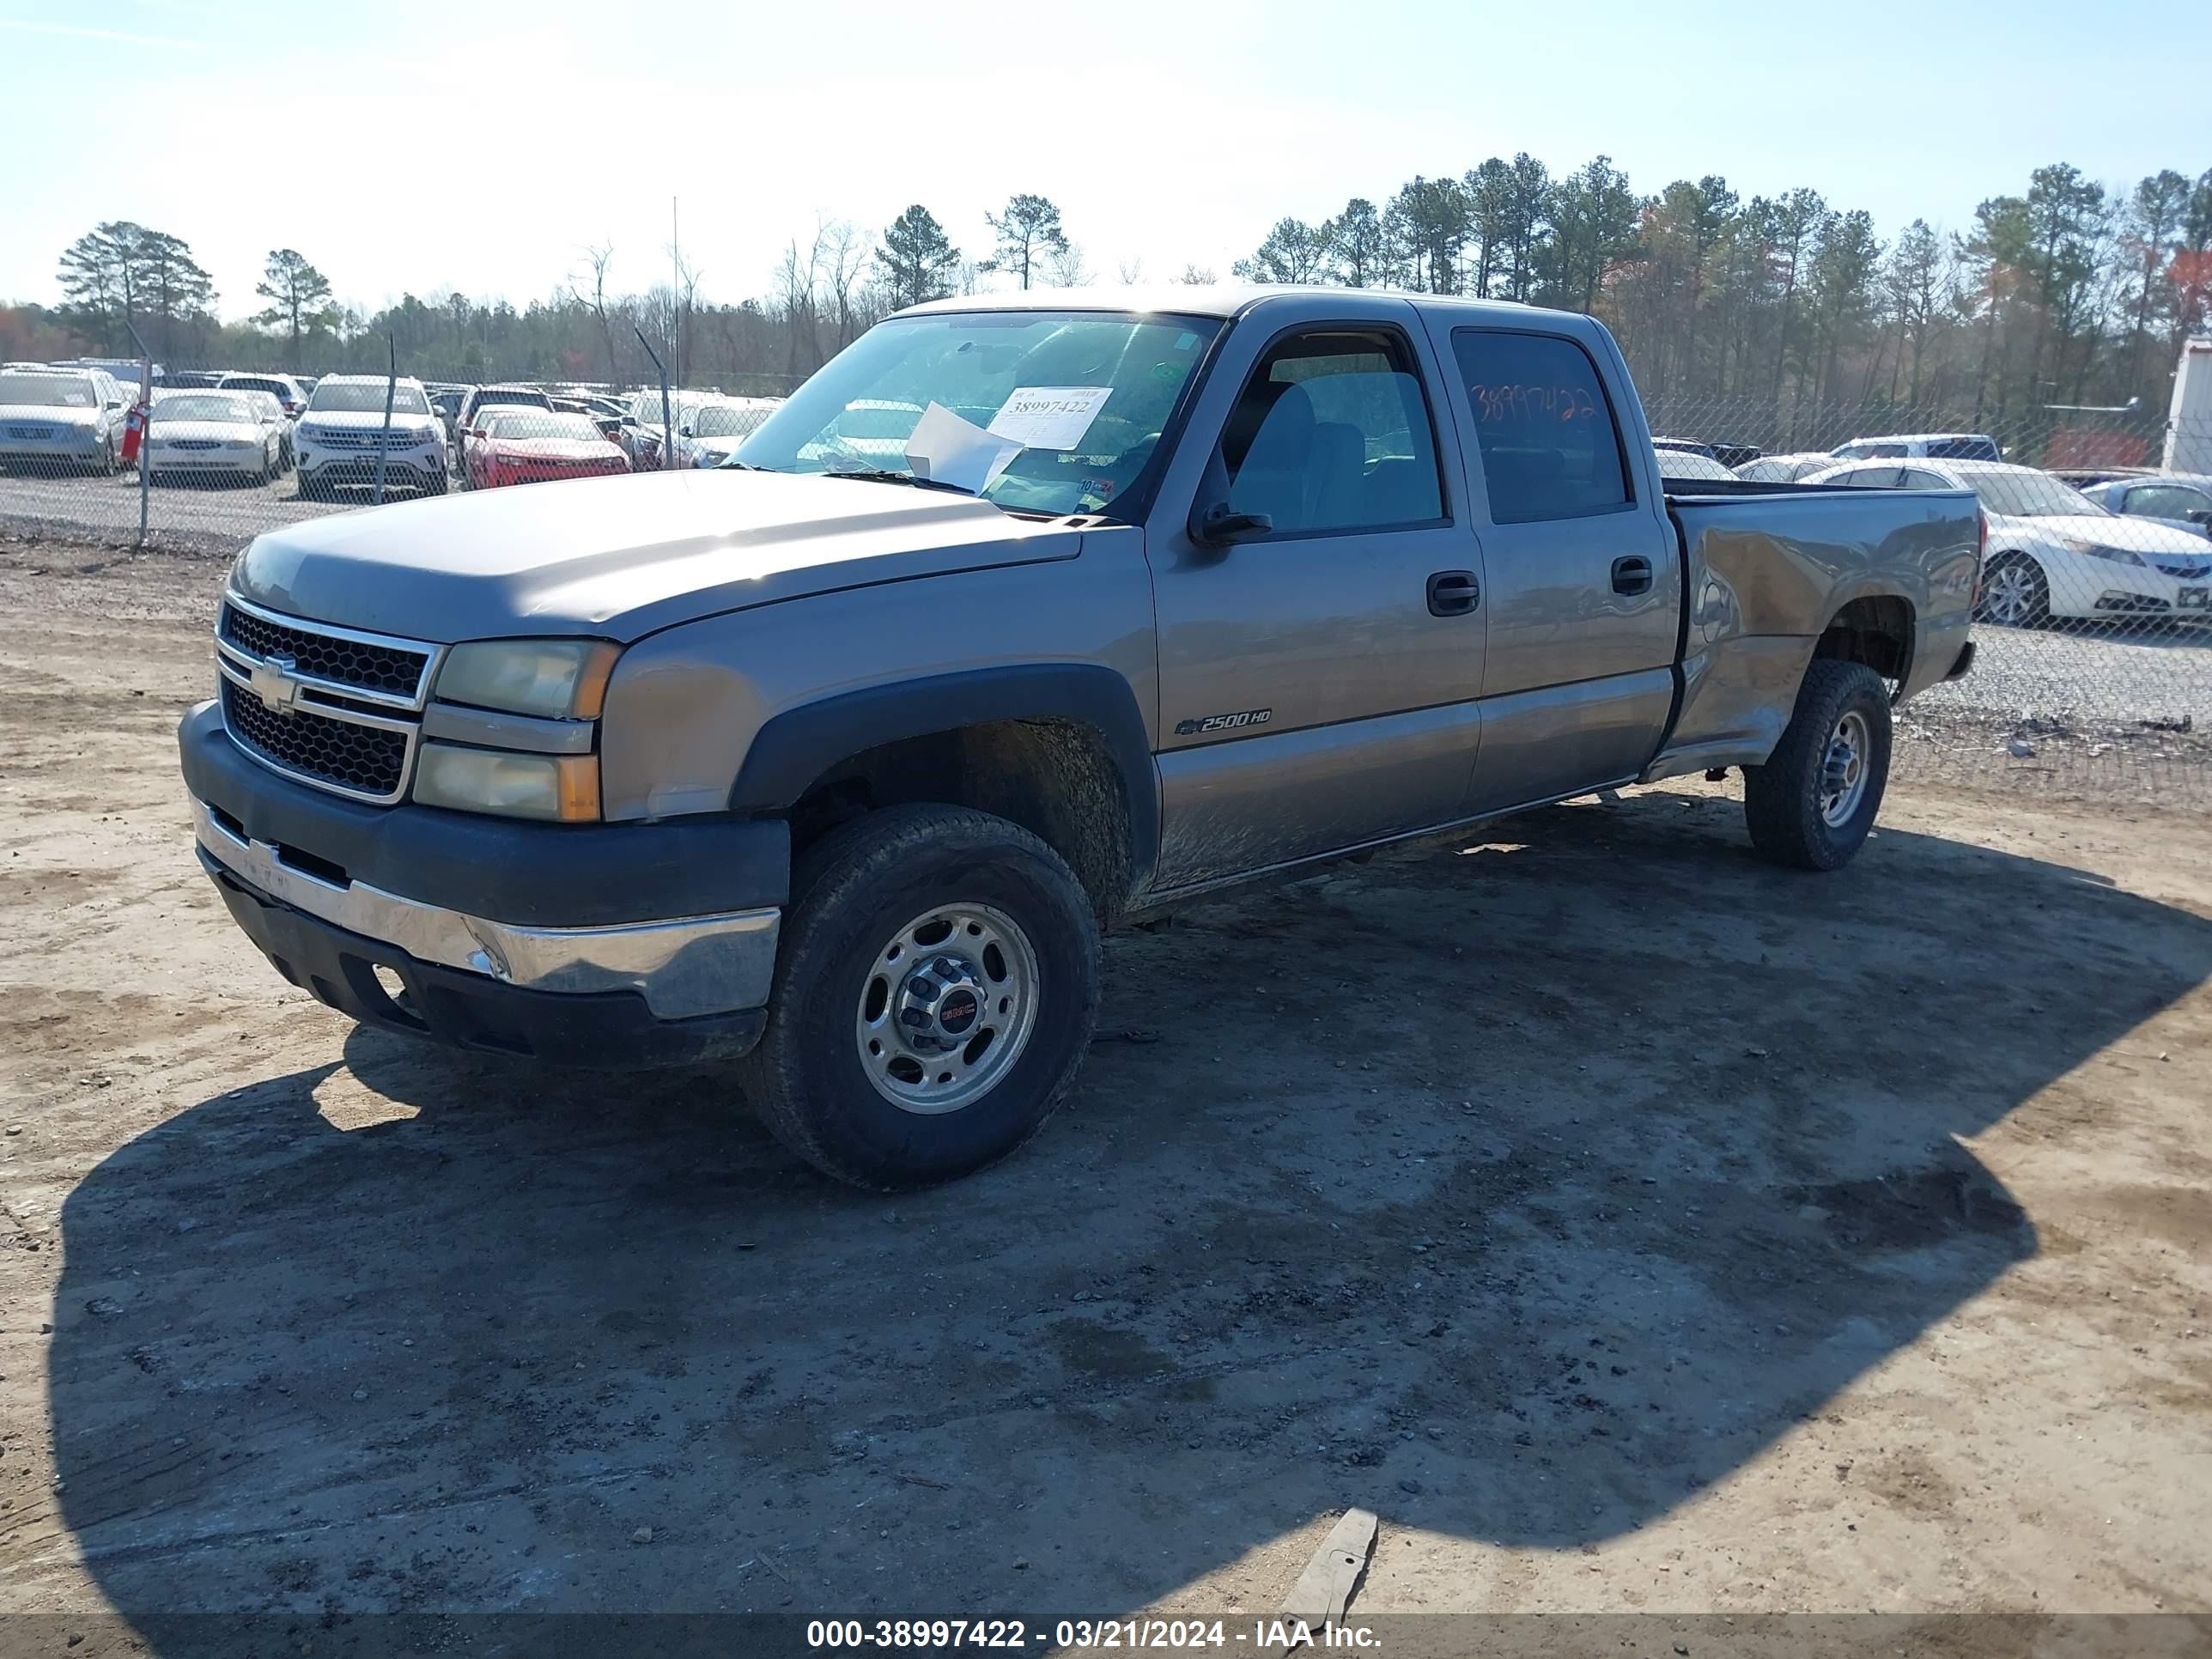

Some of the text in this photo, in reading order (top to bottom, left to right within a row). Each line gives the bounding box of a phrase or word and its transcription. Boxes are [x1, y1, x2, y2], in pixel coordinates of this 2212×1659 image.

[1008, 400, 1091, 415] 38997422
[1471, 384, 1600, 422] 38997422
[1201, 710, 1271, 732] 2500 HD
[941, 1003, 975, 1021] GMC
